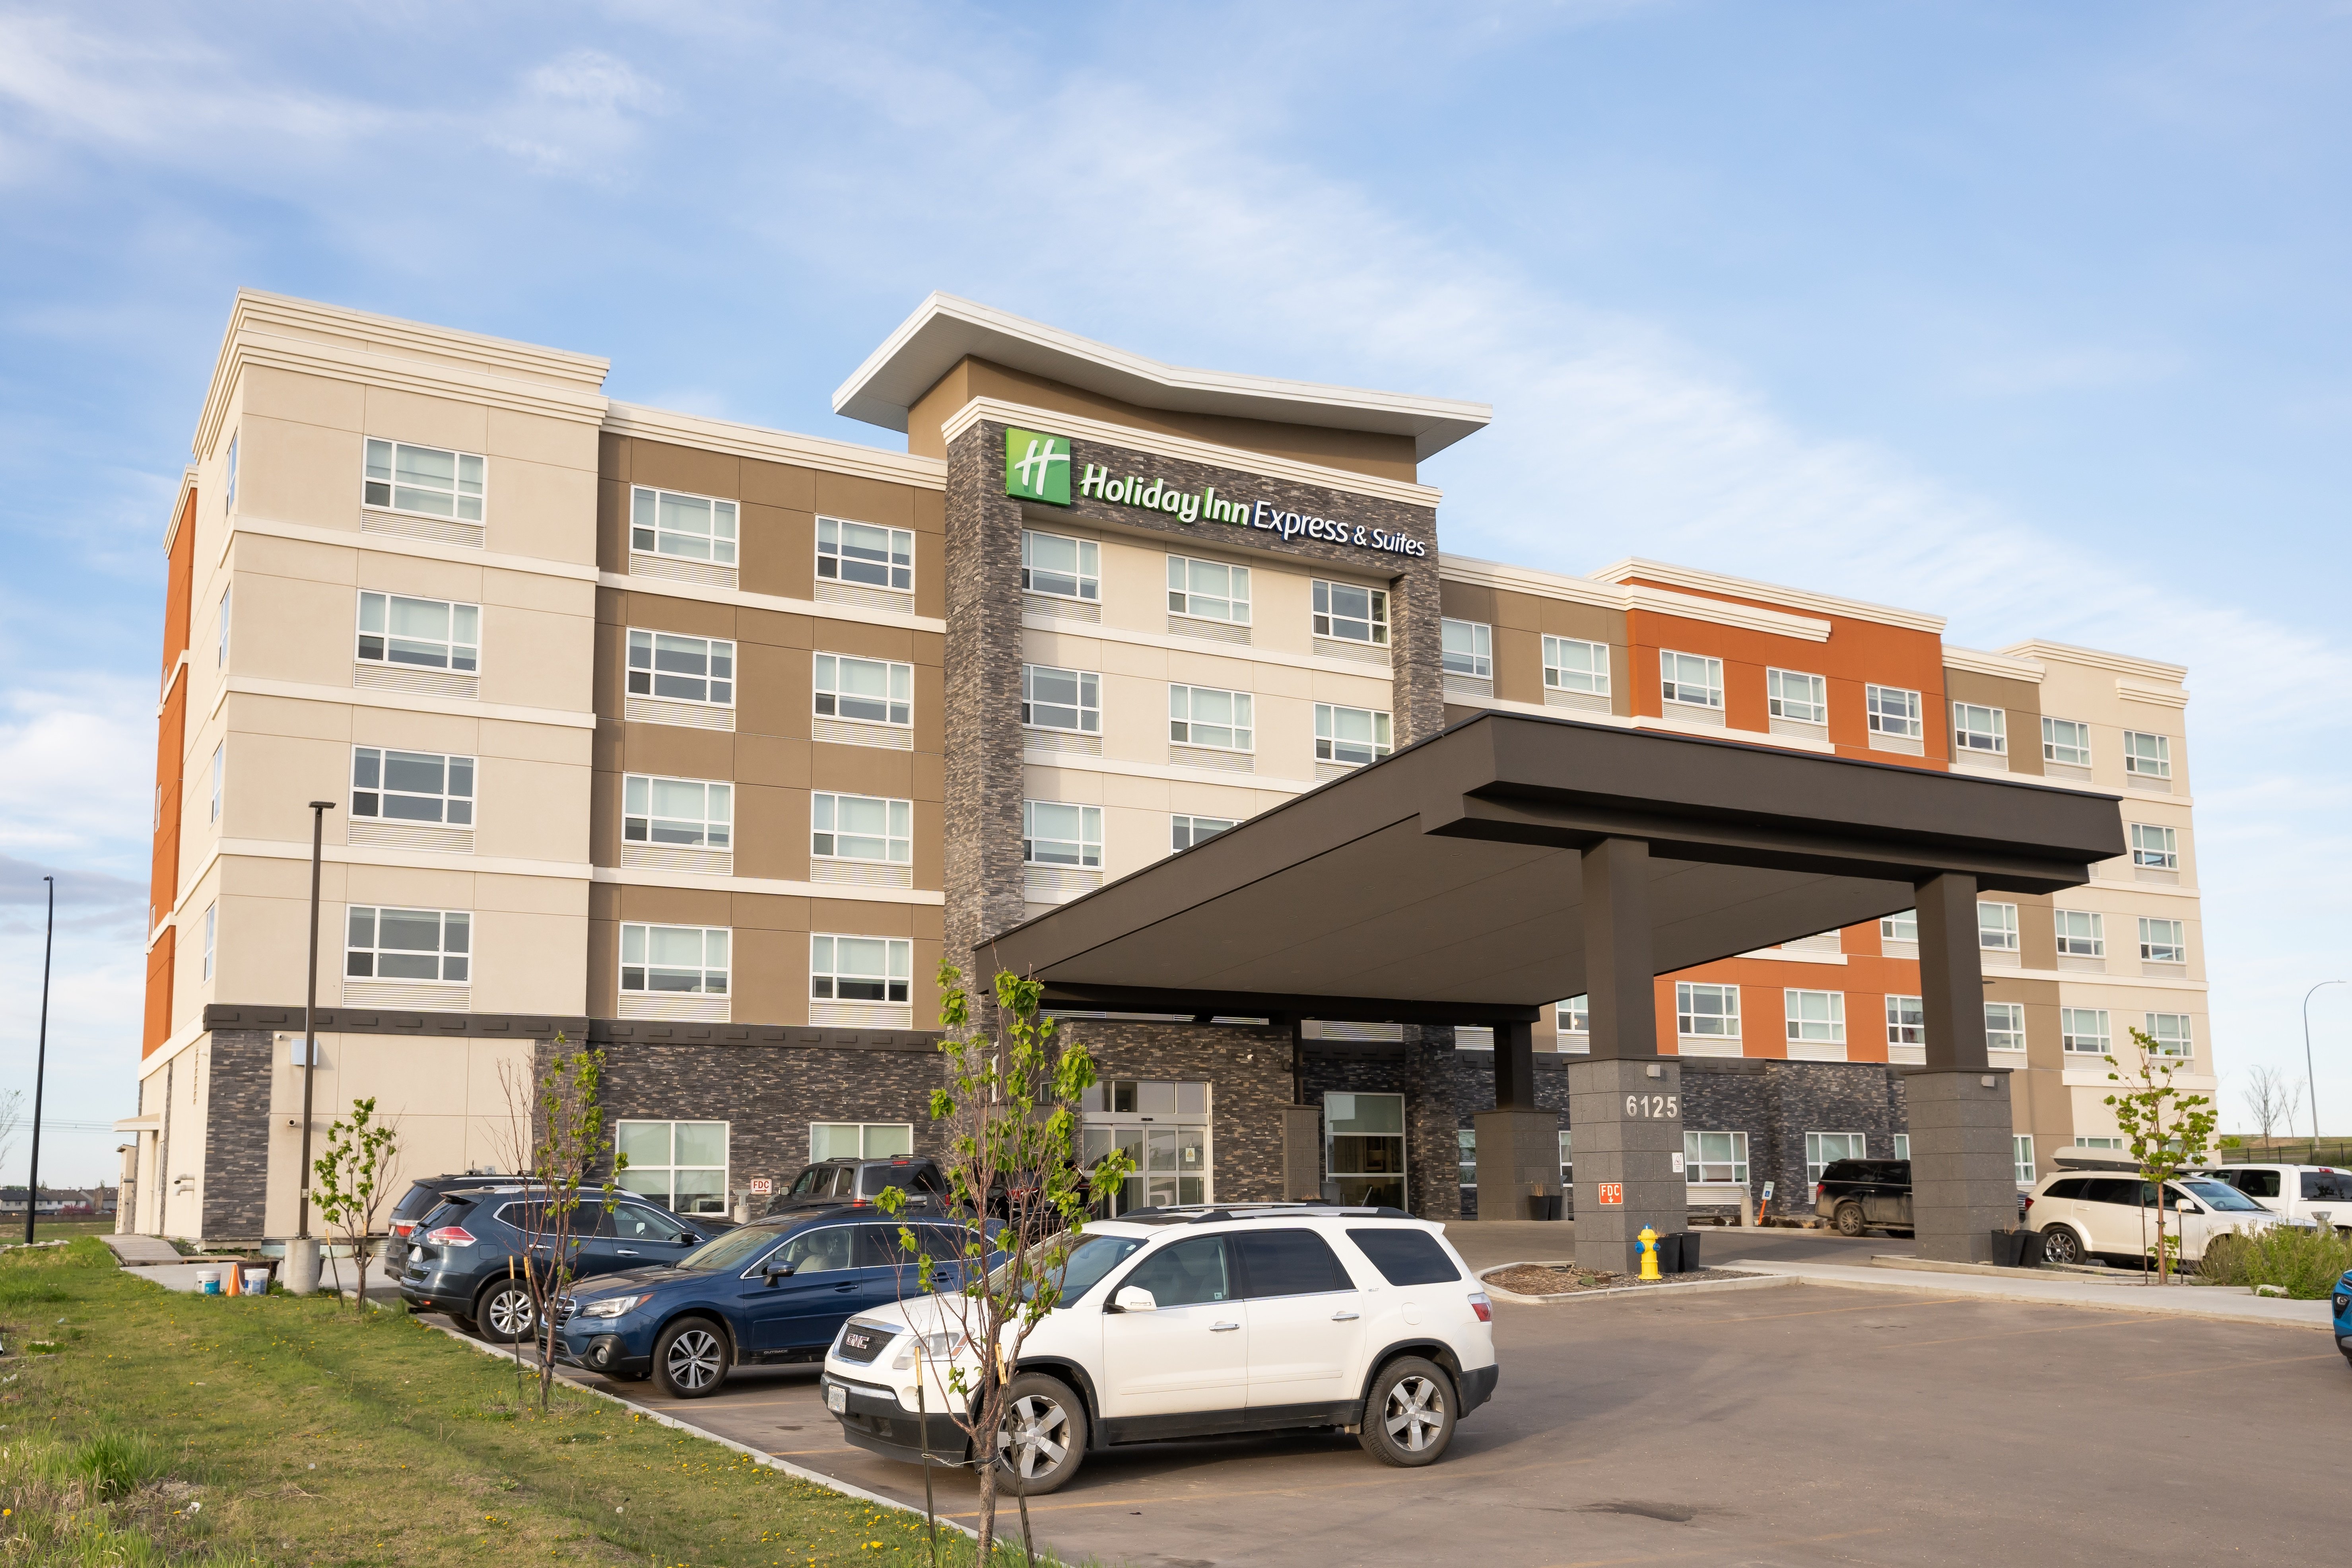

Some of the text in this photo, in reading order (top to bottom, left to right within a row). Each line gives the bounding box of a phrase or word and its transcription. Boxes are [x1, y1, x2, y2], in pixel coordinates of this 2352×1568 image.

[1079, 463, 1426, 556] Holiday Inn Express & Suites
[1626, 1095, 1678, 1118] 6125
[1601, 1185, 1620, 1196] FDC
[846, 1333, 870, 1349] GMC
